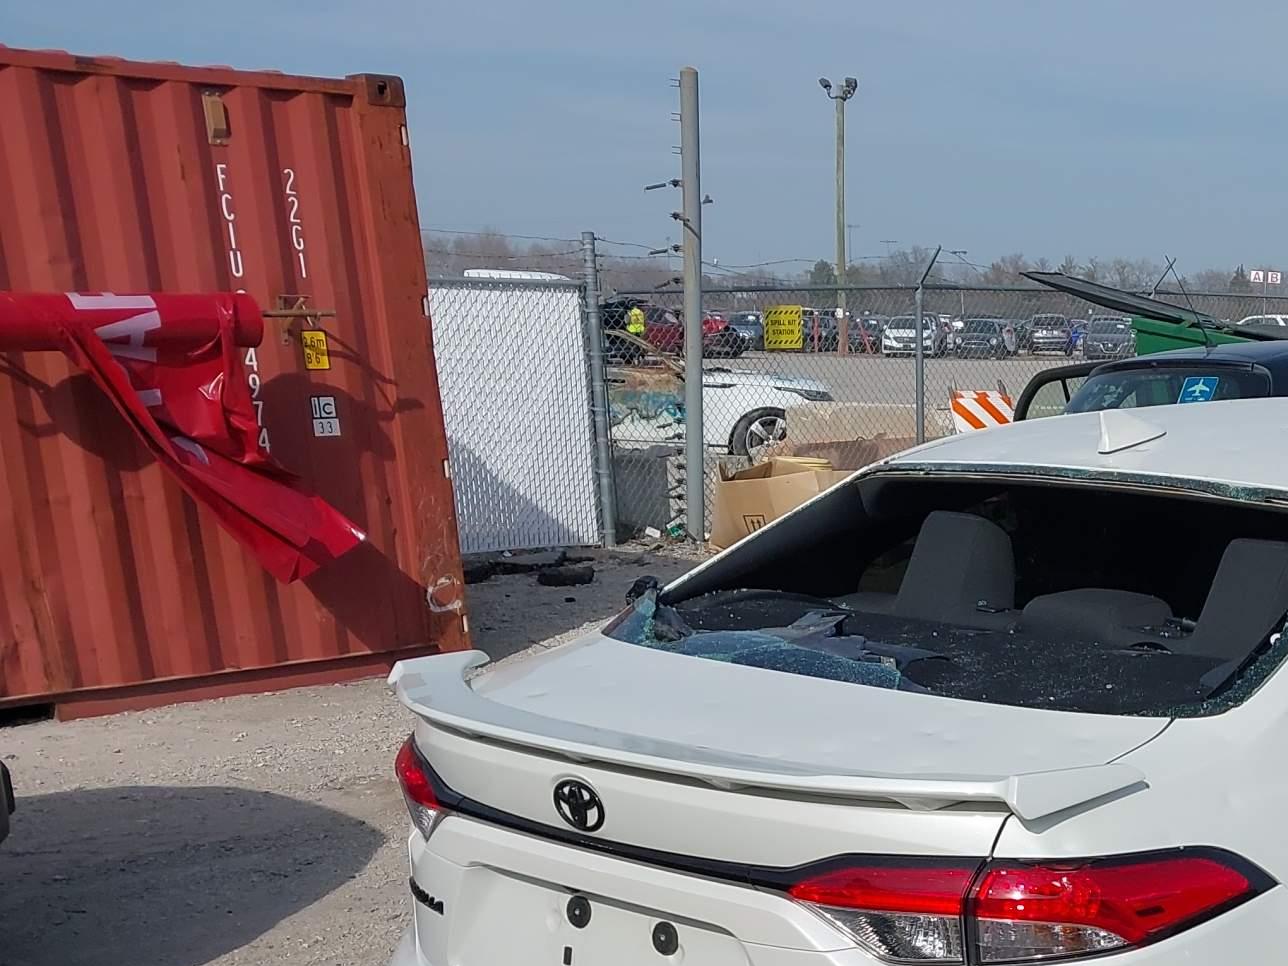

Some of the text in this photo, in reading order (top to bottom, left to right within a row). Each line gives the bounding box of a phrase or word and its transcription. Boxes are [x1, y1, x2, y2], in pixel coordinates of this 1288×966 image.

[217, 164, 243, 277] FCIU
[284, 168, 306, 278] 22G1
[772, 328, 794, 336] STATION
[318, 421, 333, 434] 33
